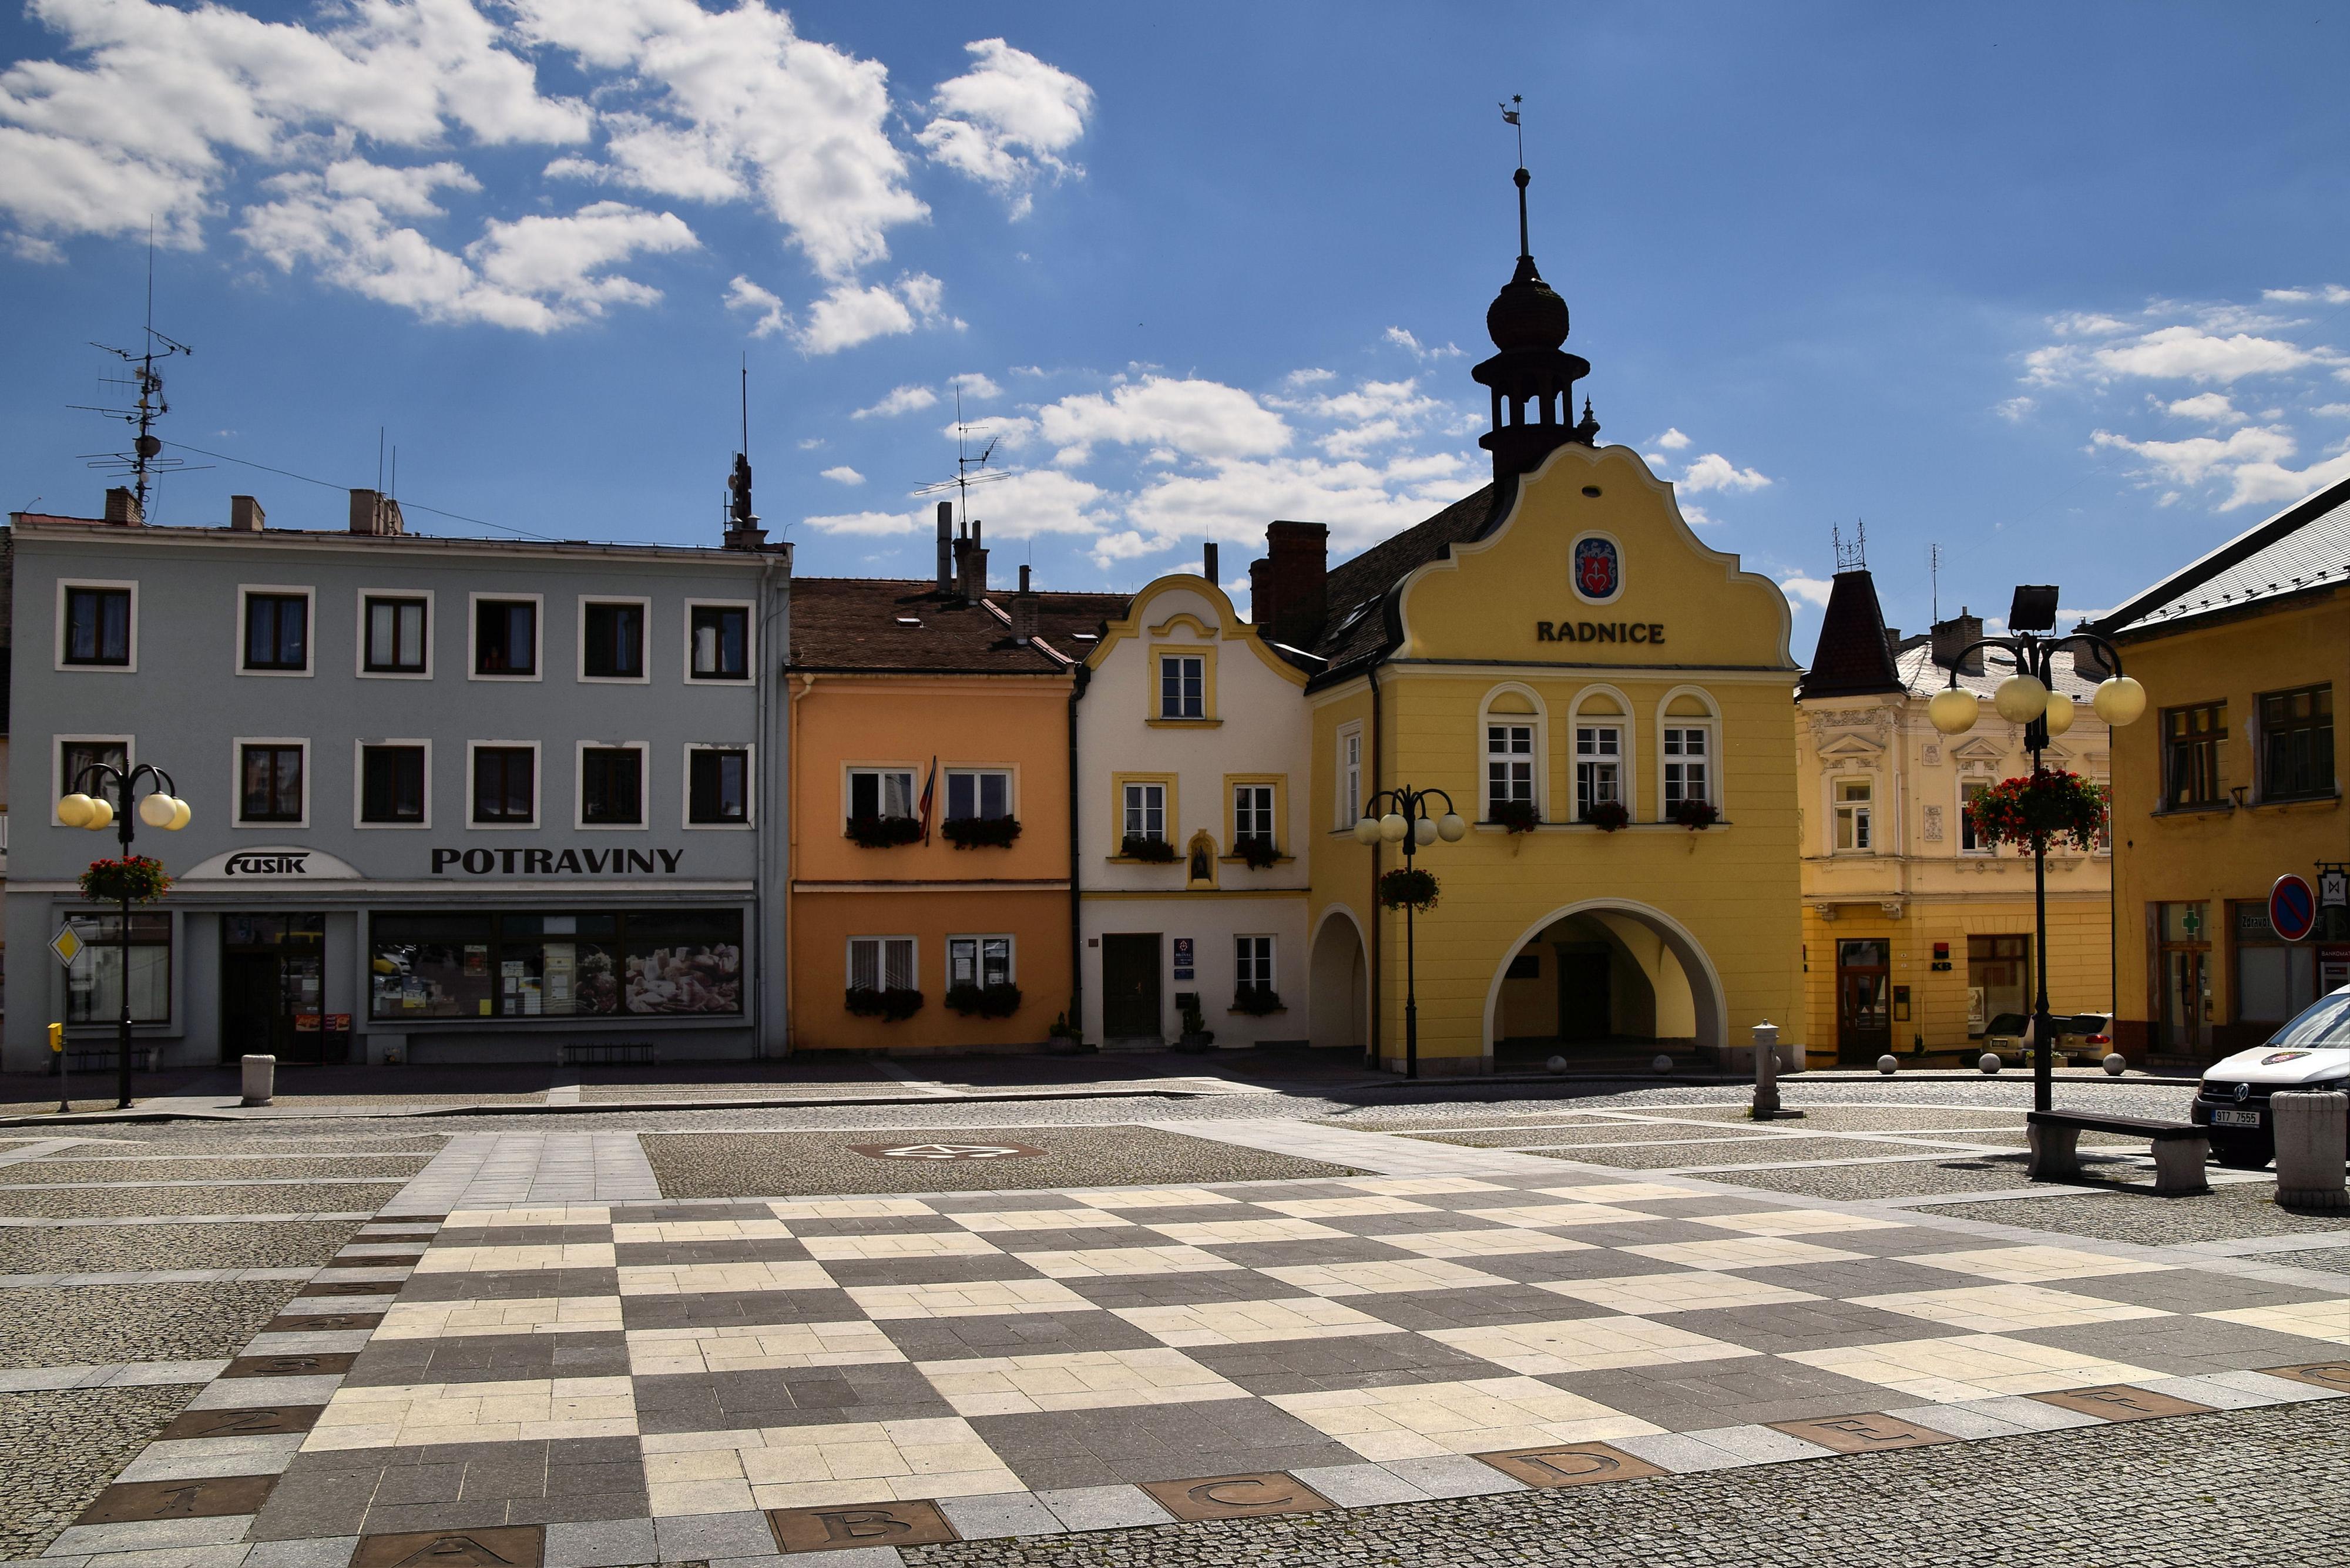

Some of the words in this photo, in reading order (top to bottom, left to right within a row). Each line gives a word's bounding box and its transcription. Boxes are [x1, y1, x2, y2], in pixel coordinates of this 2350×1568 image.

[1537, 621, 1665, 644] RADNICE
[431, 848, 684, 874] POTRAVINY
[1932, 962, 1952, 971] KB
[2217, 1111, 2231, 1122] 9T7
[2237, 1112, 2256, 1123] 7555
[325, 1284, 376, 1294] 5
[287, 1315, 355, 1329] 4
[254, 1357, 320, 1372] 3
[2069, 1391, 2154, 1413] F
[199, 1411, 281, 1434] 2
[1810, 1419, 1917, 1442] E
[1508, 1452, 1622, 1480] D
[154, 1483, 206, 1514] 1
[1183, 1479, 1294, 1506] C
[810, 1509, 913, 1543] B
[390, 1536, 515, 1568] A
